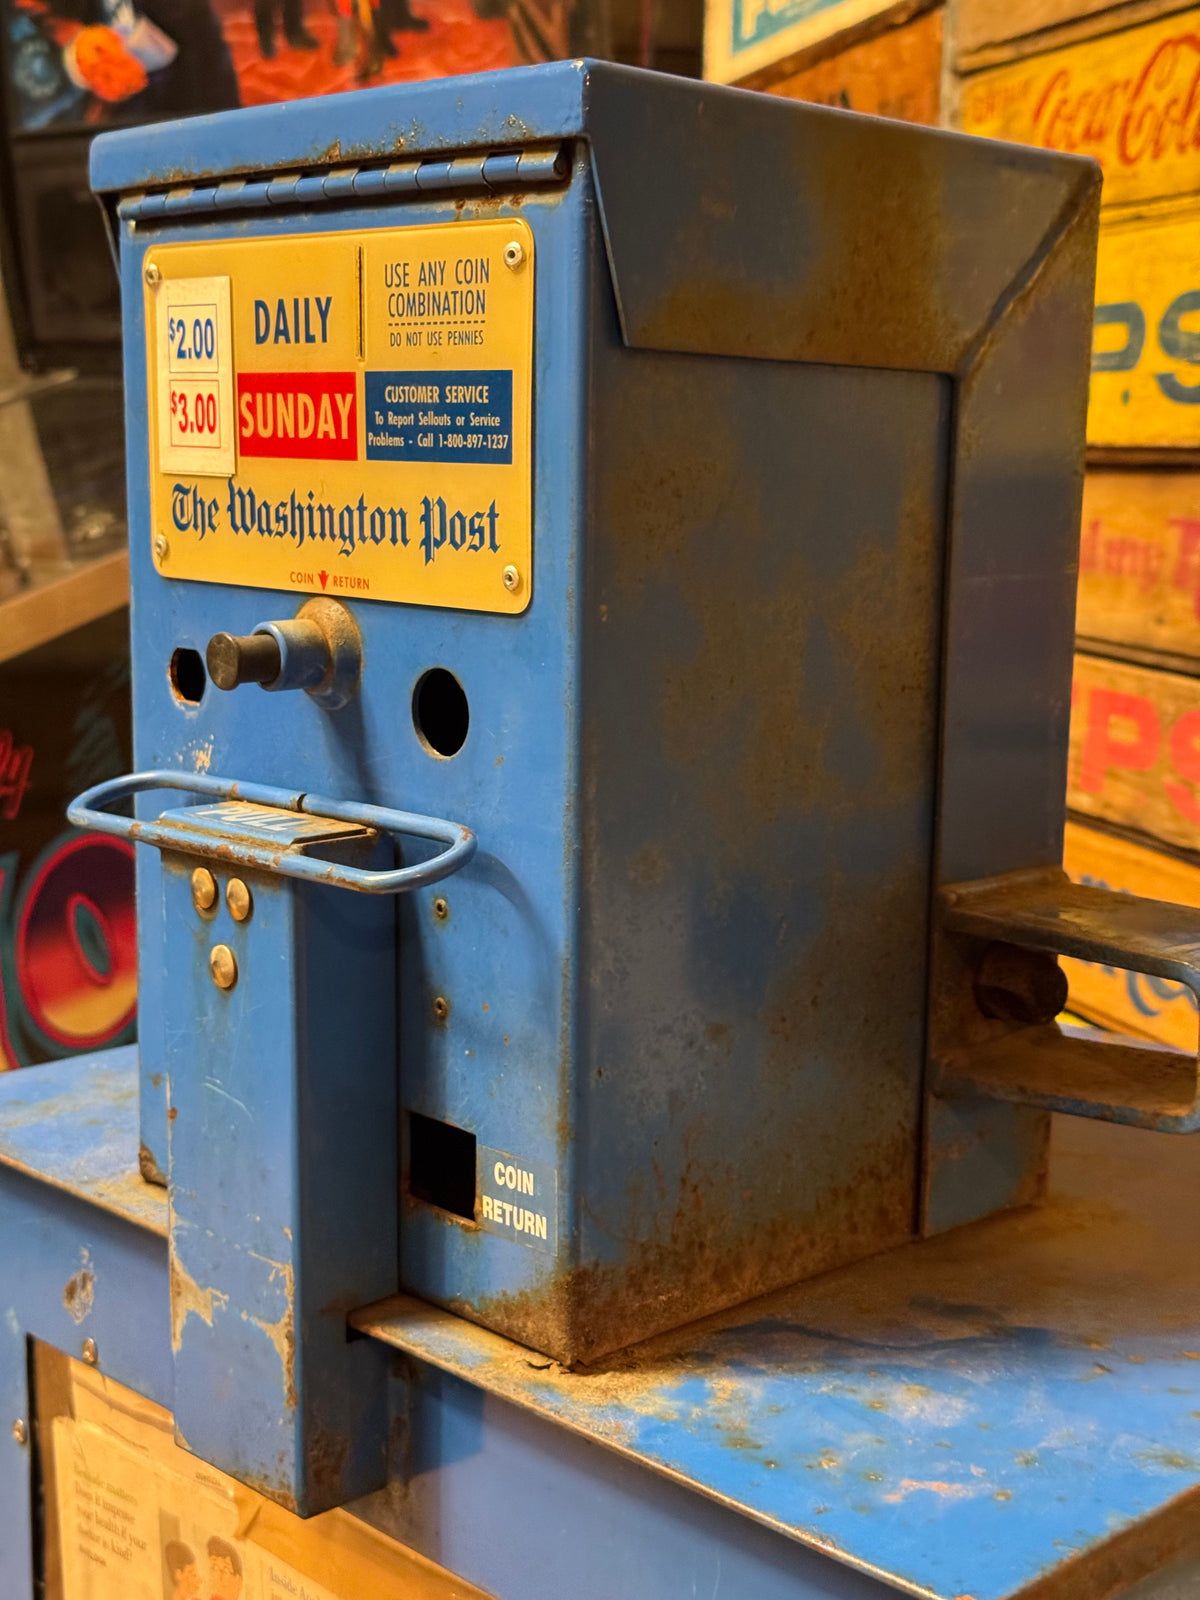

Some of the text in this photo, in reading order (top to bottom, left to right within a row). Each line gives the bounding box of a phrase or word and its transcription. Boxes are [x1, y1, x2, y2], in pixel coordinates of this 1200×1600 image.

[384, 257, 490, 288] USE ANY COIN
[388, 289, 486, 317] COMBINATION
[254, 296, 333, 344] DAILY
[168, 317, 215, 360] $2.00
[389, 330, 484, 347] DO NOT USE PENNIES
[384, 385, 490, 403] CUSTOMER SERVICE
[170, 390, 217, 435] $3.00
[240, 392, 354, 440] SUNDAY
[374, 410, 501, 428] To Report Sellouts or Service
[368, 432, 405, 447] Problems
[417, 433, 434, 448] Call
[439, 433, 509, 449] 1-800-897-1237
[171, 477, 501, 566] The Washington Post
[289, 571, 370, 590] COIN RETURN
[195, 806, 309, 832] PULL
[493, 1161, 535, 1196] COIN
[481, 1194, 548, 1240] RETURN
